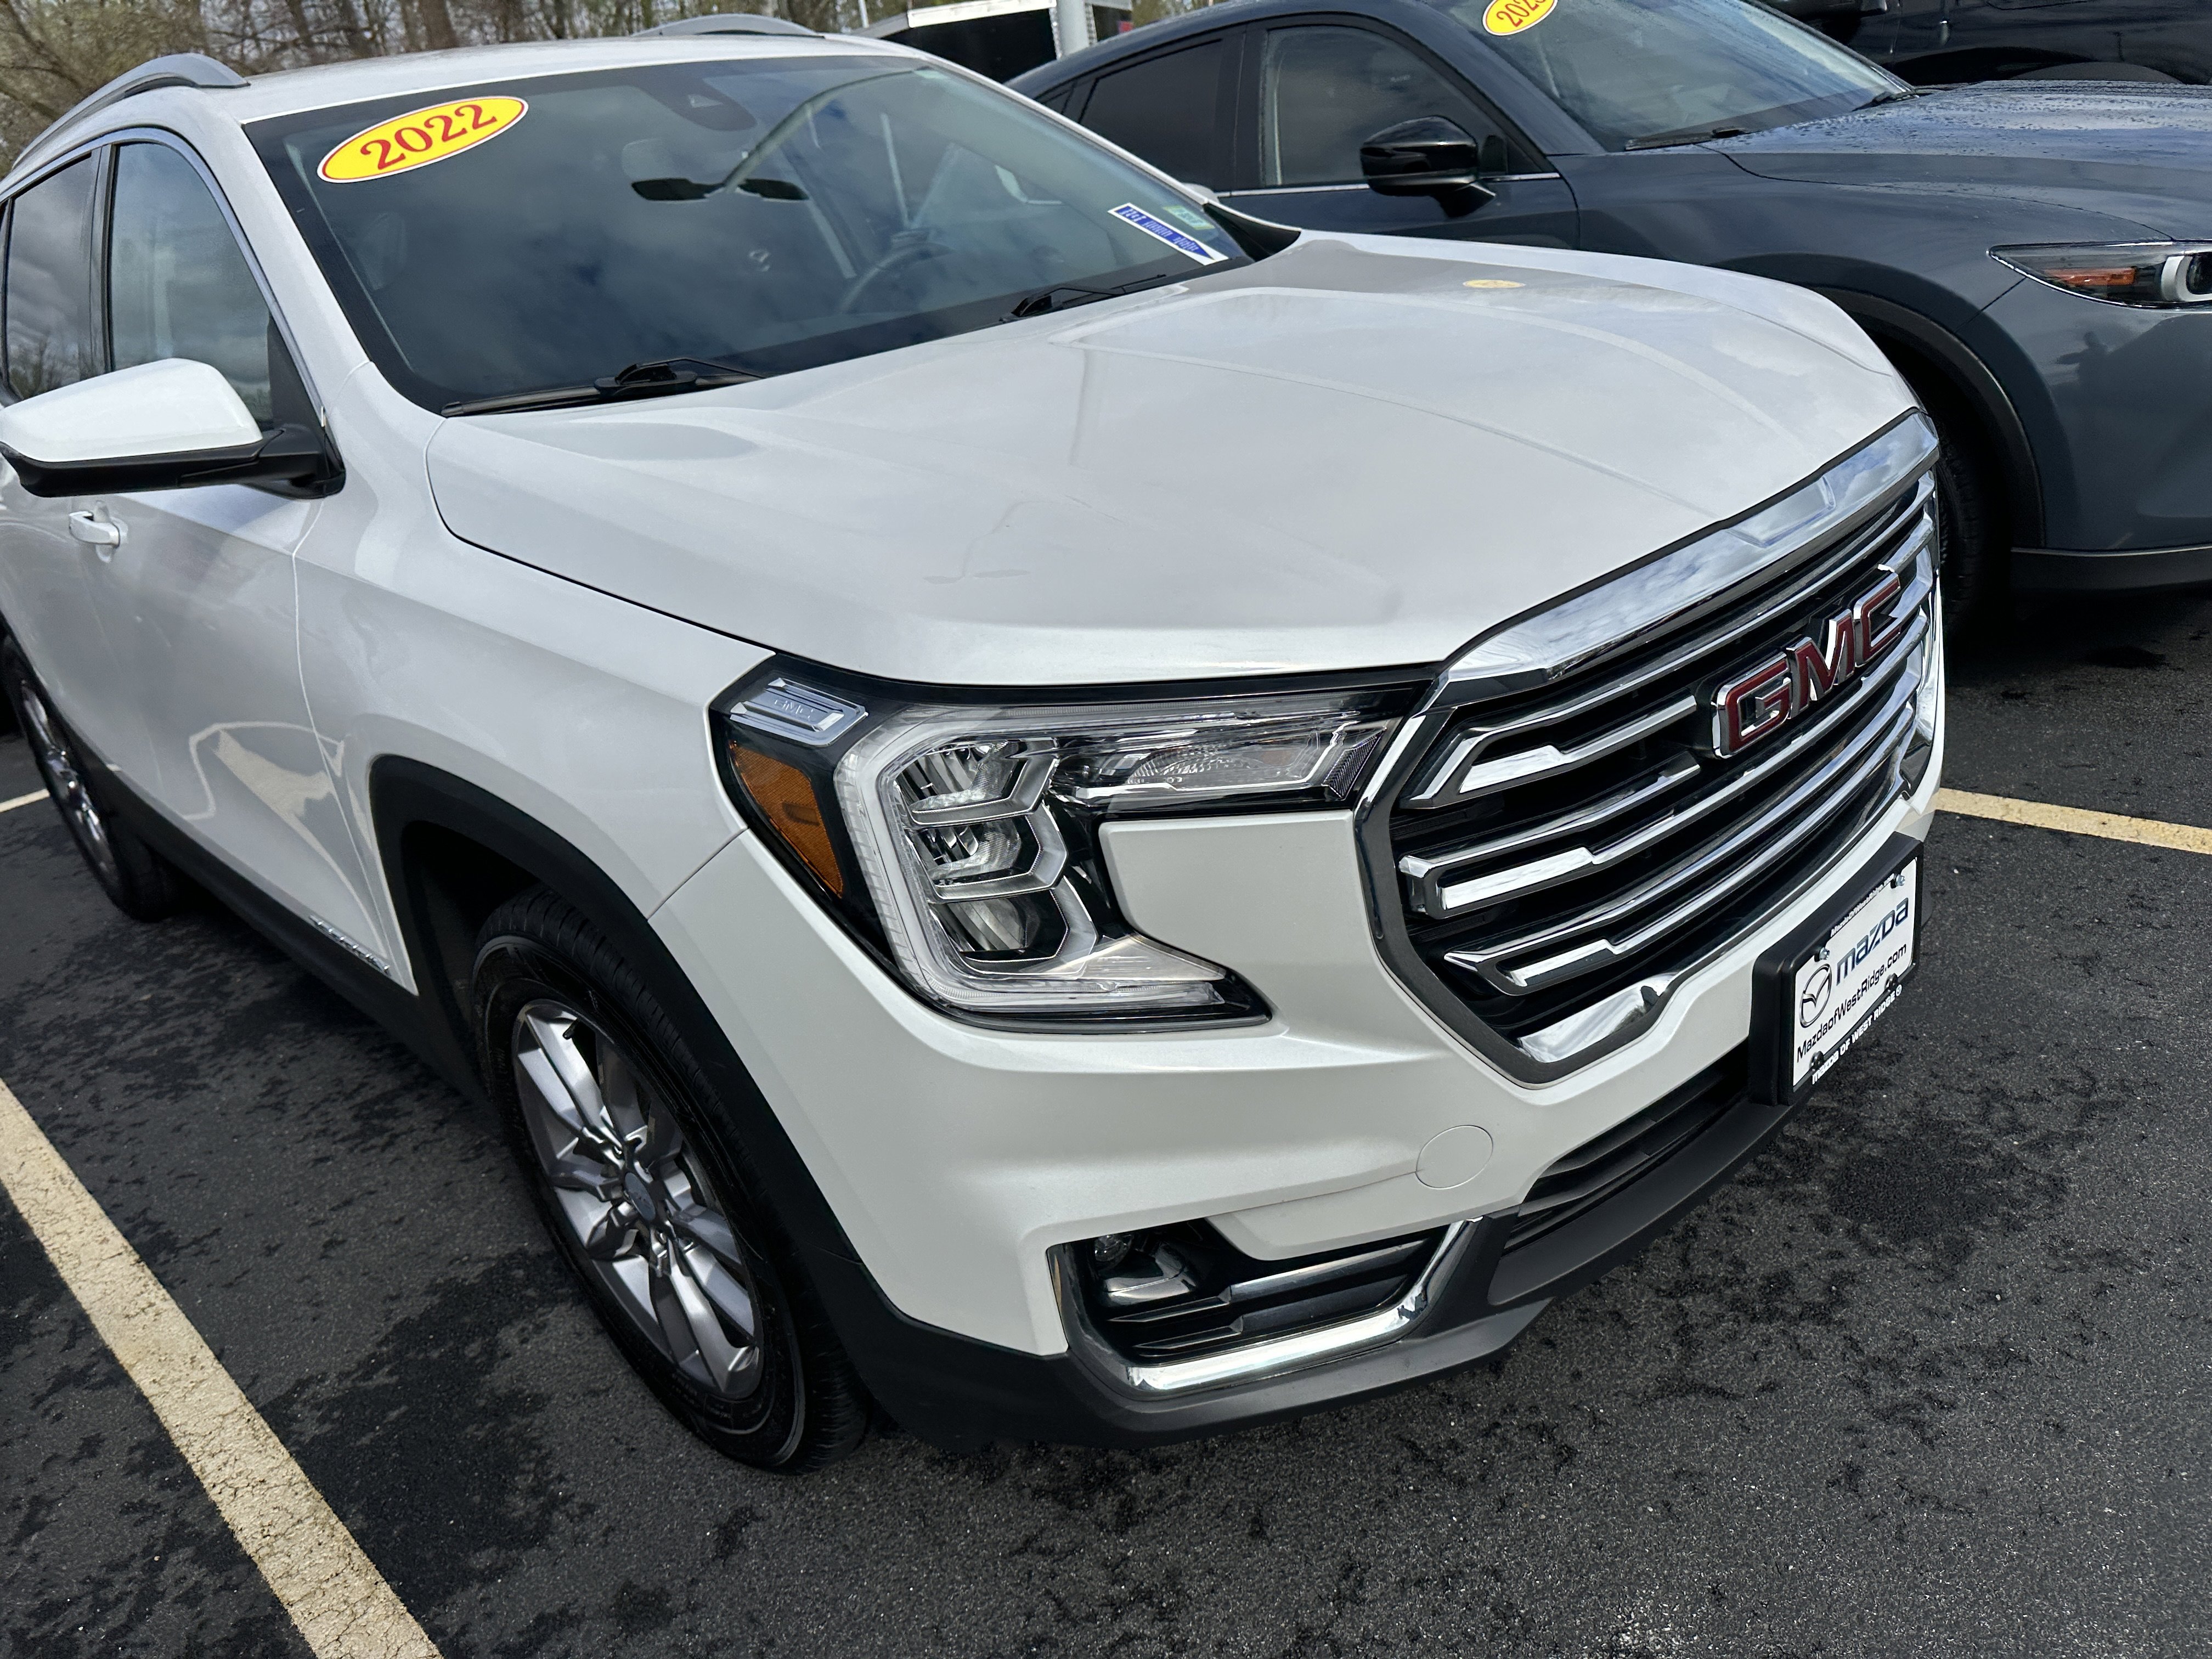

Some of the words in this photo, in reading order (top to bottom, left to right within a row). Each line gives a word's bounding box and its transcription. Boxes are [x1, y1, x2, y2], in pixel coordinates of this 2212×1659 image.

[1496, 0, 1545, 27] 202
[360, 104, 497, 170] 2022
[1713, 572, 1901, 758] GMC
[1797, 944, 1907, 1063] MazdaofWestRidge.com
[1839, 1038, 1850, 1056] OF
[1851, 1015, 1873, 1044] WEST
[1874, 991, 1896, 1021] RIDGE
